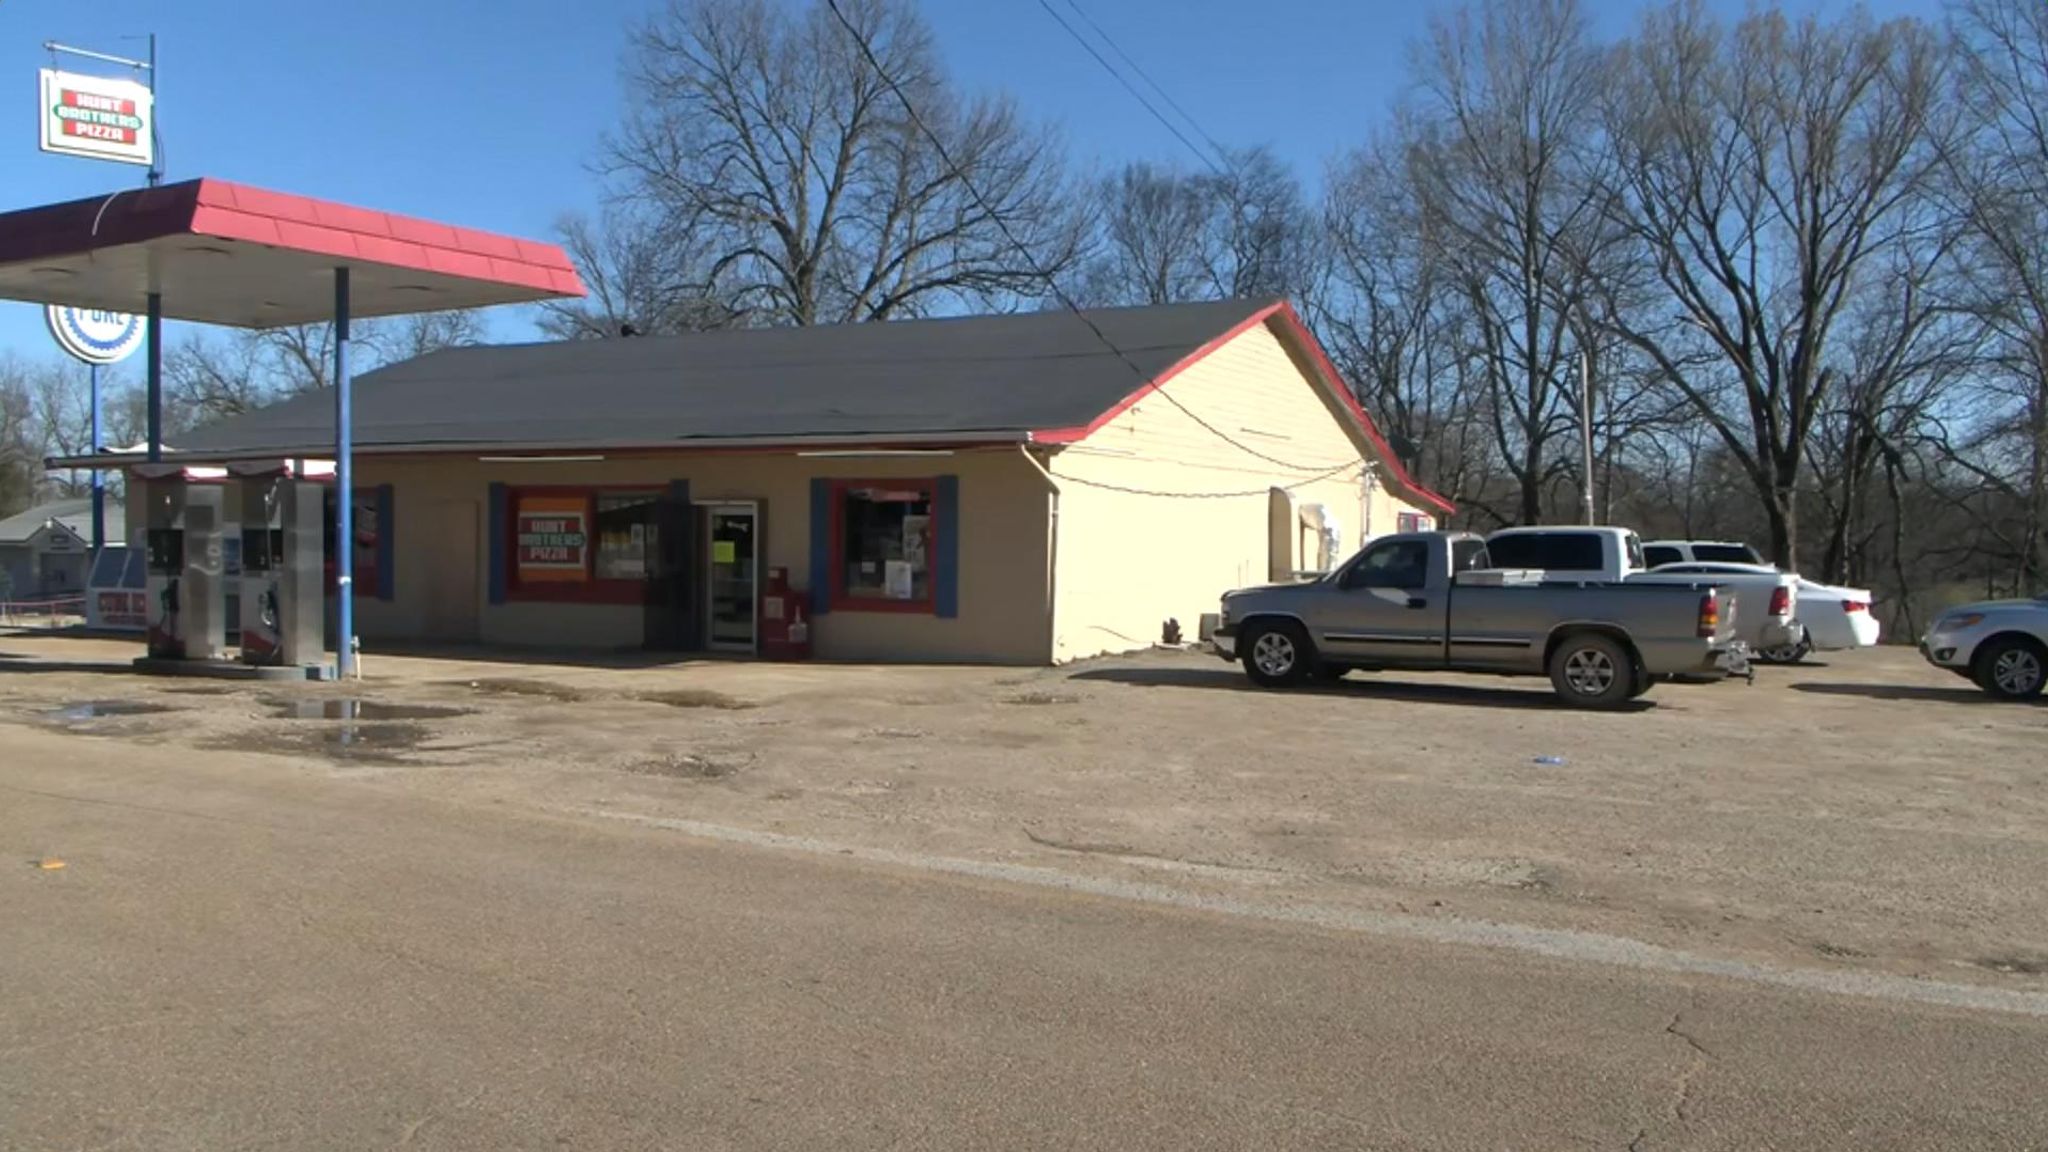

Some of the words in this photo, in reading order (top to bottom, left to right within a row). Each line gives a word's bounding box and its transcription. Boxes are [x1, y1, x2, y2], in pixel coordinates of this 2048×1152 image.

[58, 106, 140, 129] BROTHERS
[75, 124, 123, 141] PIZZA
[531, 520, 566, 532] HUNT
[530, 546, 568, 560] PIZZA
